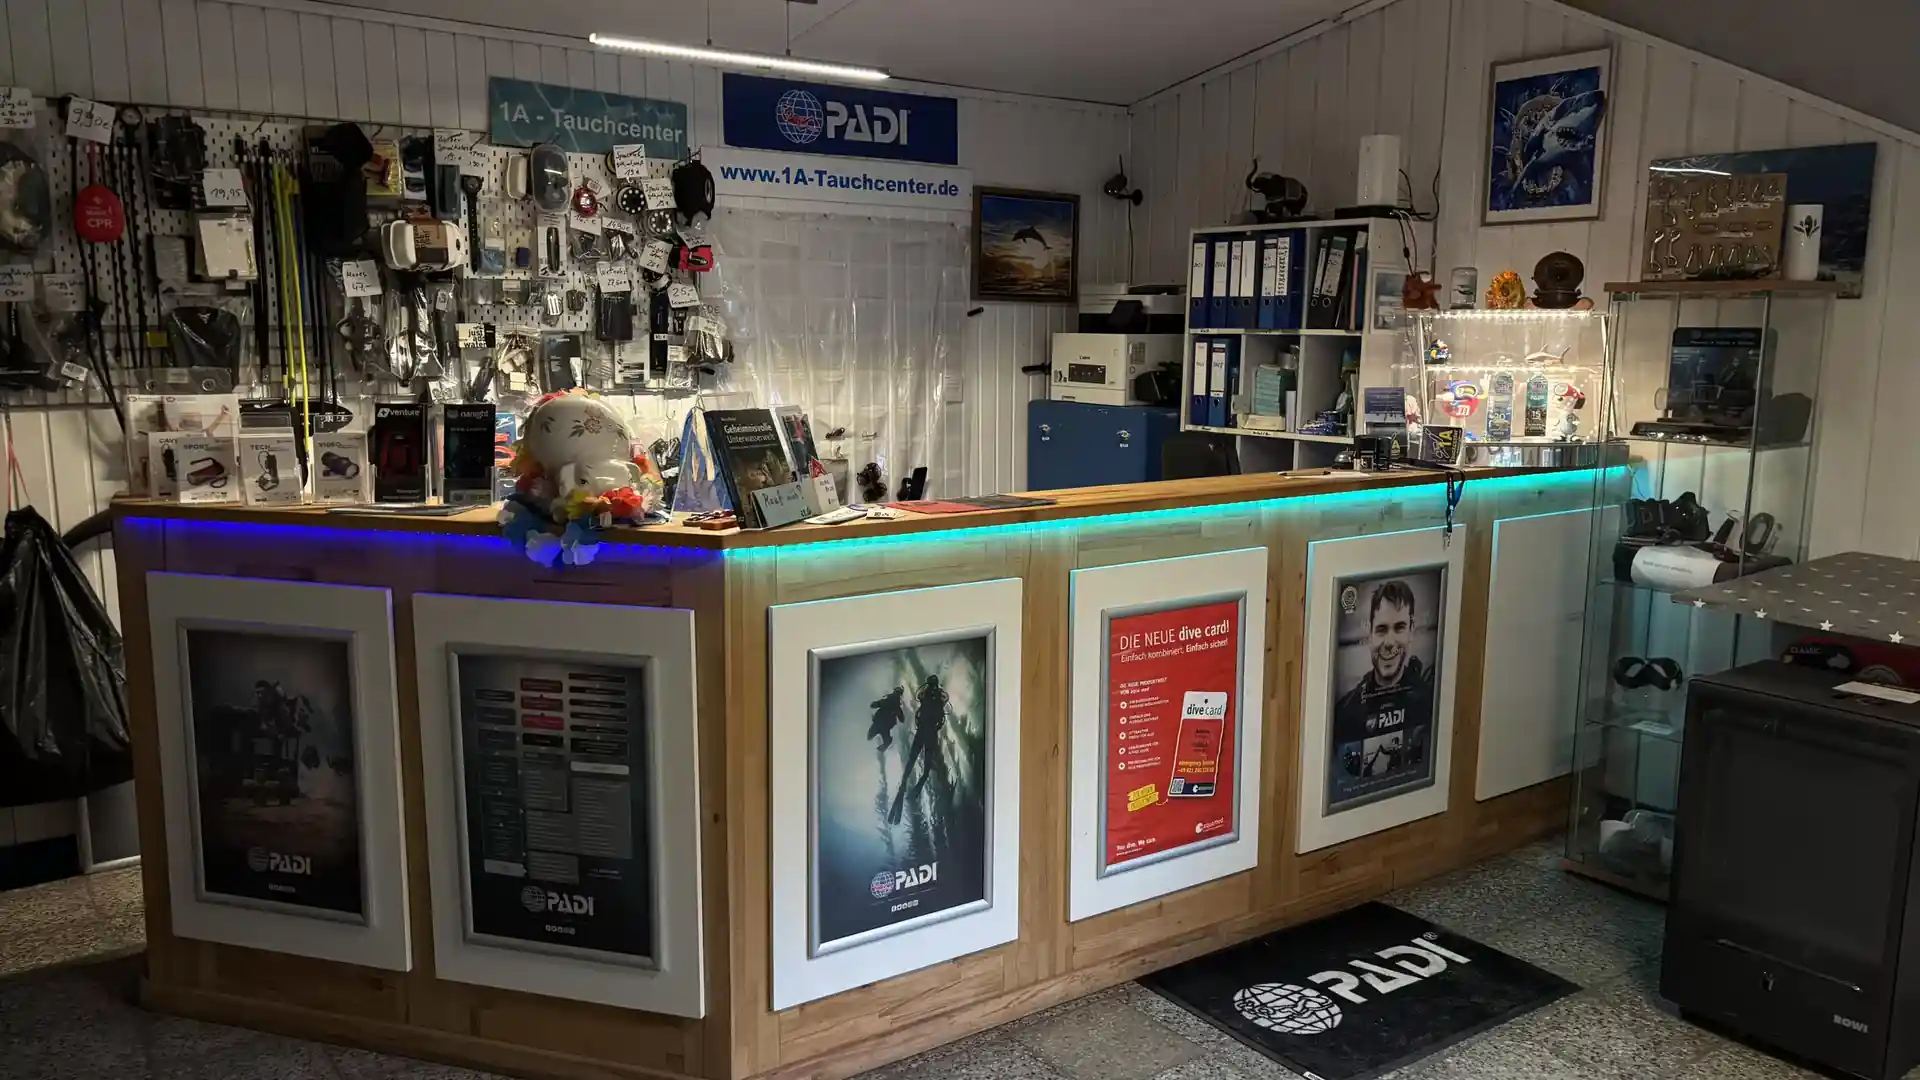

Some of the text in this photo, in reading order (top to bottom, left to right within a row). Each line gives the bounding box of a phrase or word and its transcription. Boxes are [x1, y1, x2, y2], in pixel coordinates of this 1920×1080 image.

[500, 100, 531, 123] 1A
[554, 108, 682, 144] Tauchcenter
[824, 101, 909, 146] PADI
[720, 164, 960, 197] www.1A-Tauchcenter.de
[87, 218, 114, 229] CPR
[389, 408, 420, 417] venture
[1120, 619, 1230, 650] DIE NEUE dive card!
[1120, 652, 1146, 663] Einfach
[1185, 642, 1209, 653] Einfach
[1186, 703, 1223, 716] dive card
[1378, 708, 1406, 729] PADI
[269, 850, 313, 876] PADI
[894, 861, 938, 891] PADI
[547, 891, 595, 917] PADI
[1307, 936, 1472, 1004] PADI
